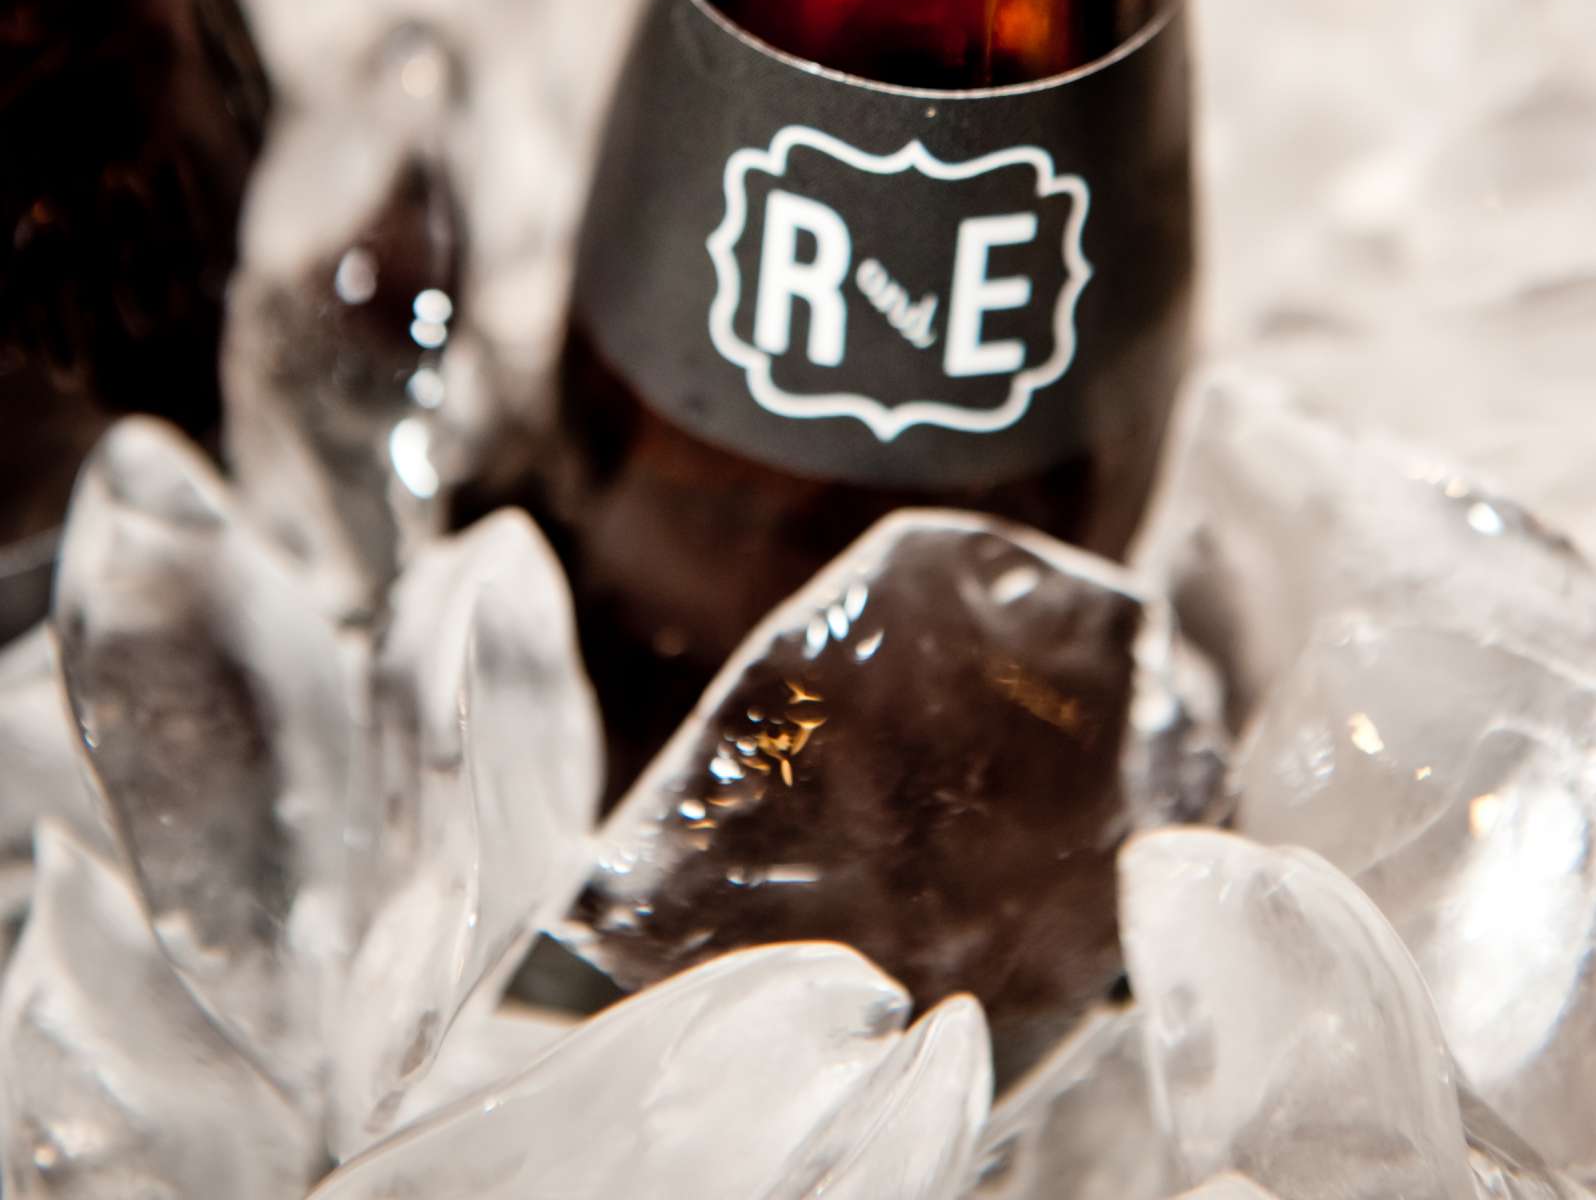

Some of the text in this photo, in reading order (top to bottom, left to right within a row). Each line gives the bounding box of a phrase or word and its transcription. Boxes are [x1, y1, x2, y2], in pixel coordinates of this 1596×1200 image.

[754, 189, 1038, 377] R and E
